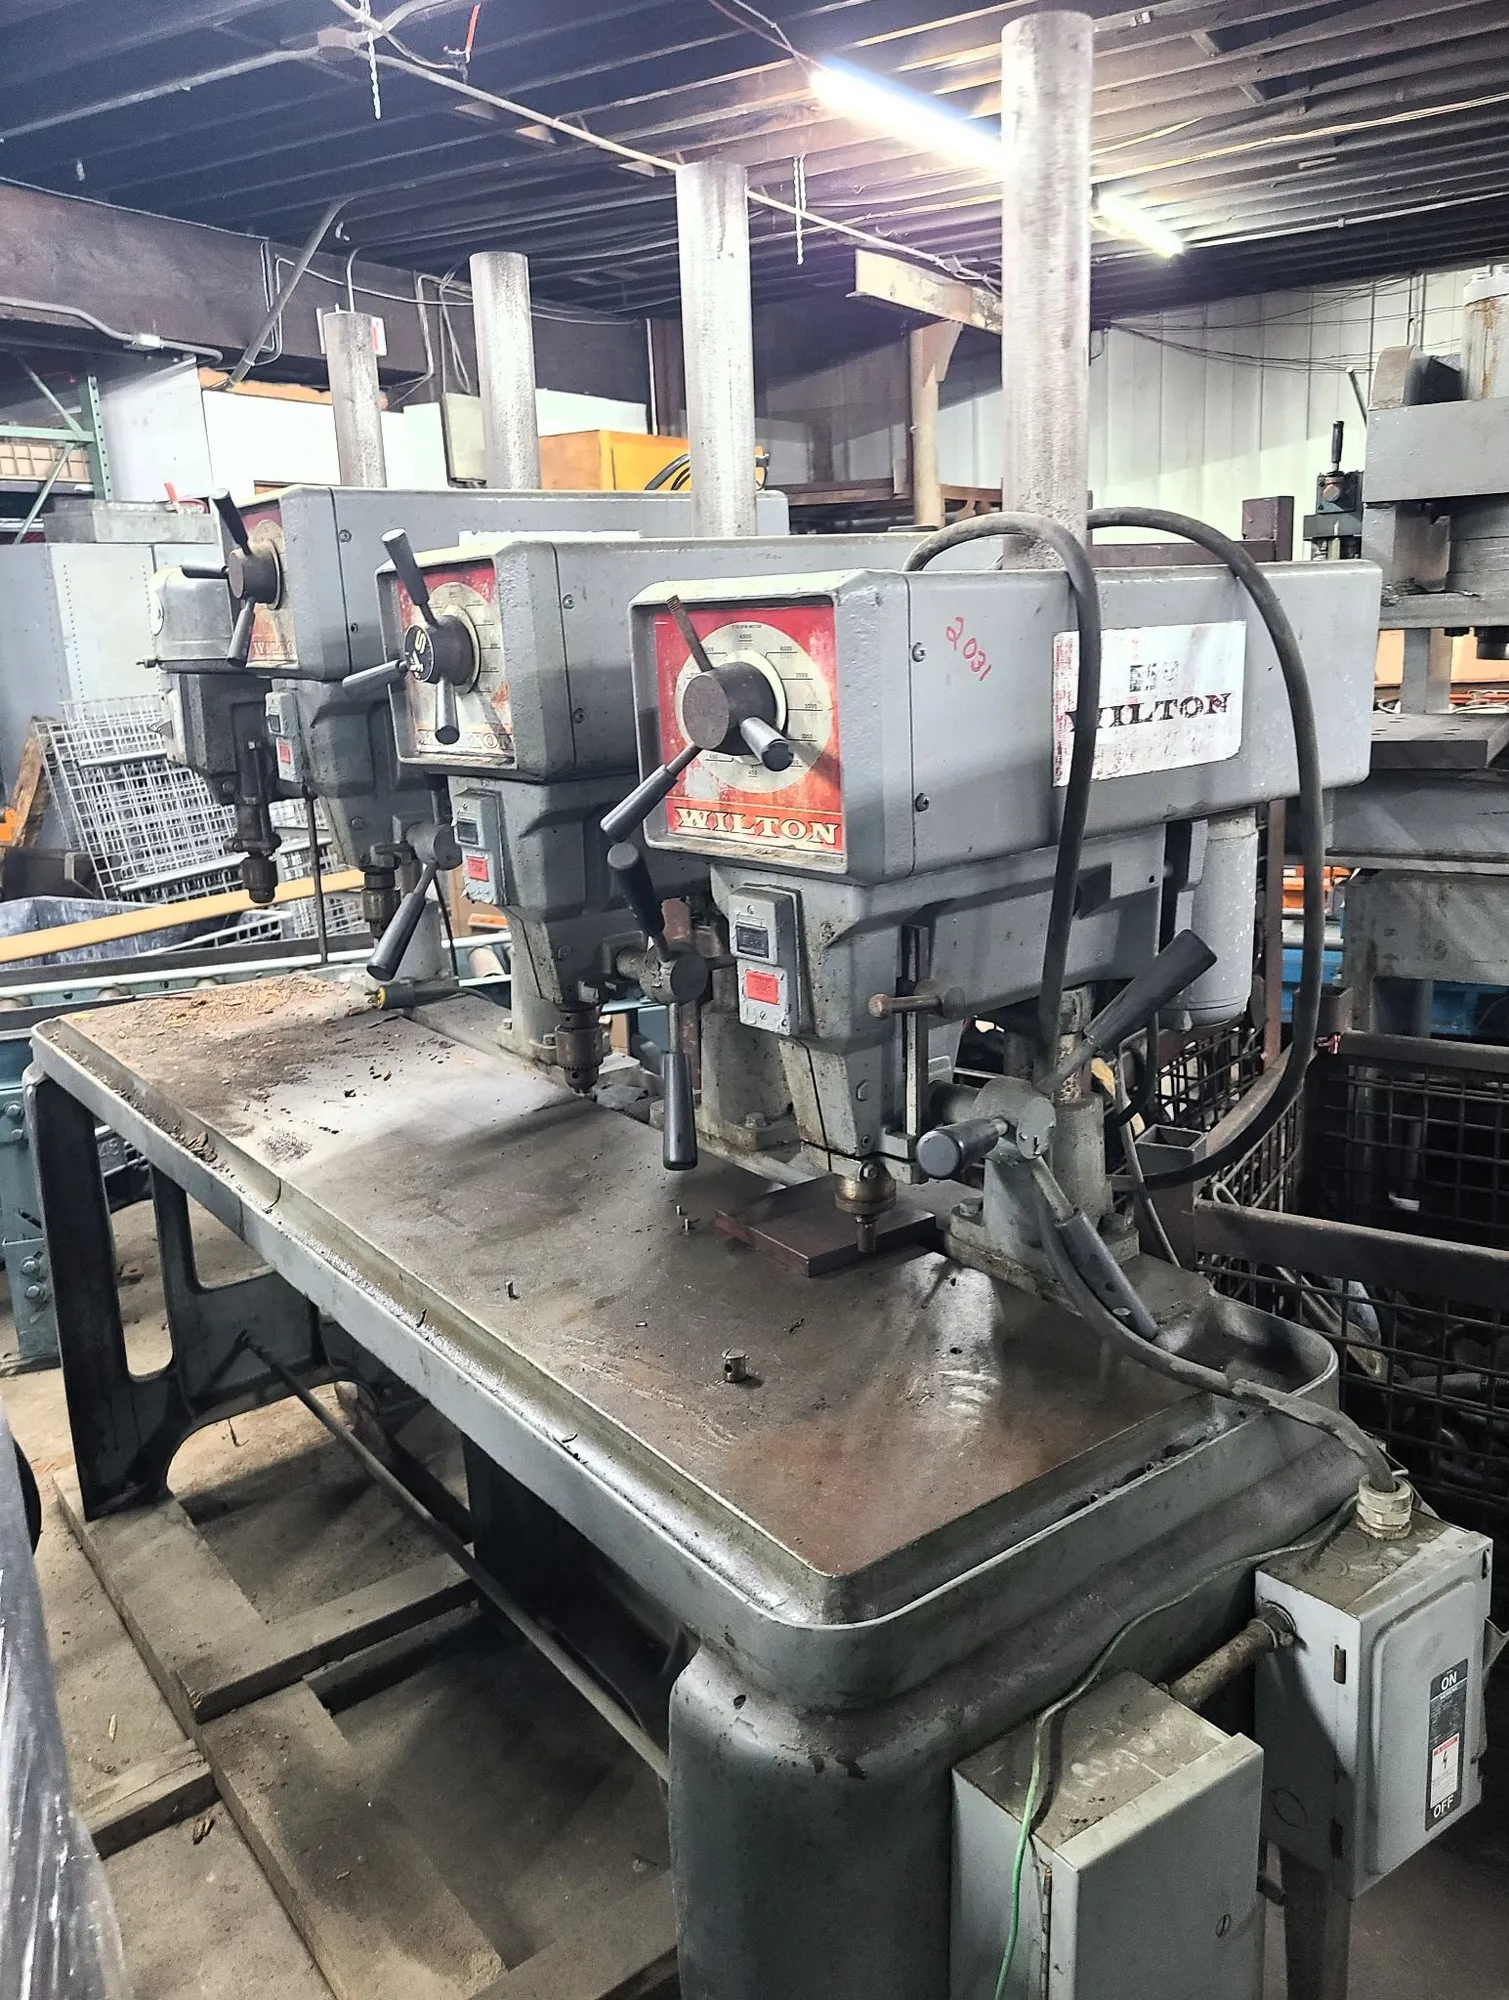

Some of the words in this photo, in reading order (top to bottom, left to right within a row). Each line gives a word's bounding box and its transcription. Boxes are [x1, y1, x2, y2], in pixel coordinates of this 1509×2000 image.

[946, 616, 992, 681] 2031
[675, 808, 840, 844] WILTON
[1440, 1670, 1458, 1691] ON
[1433, 1794, 1454, 1818] OFF
